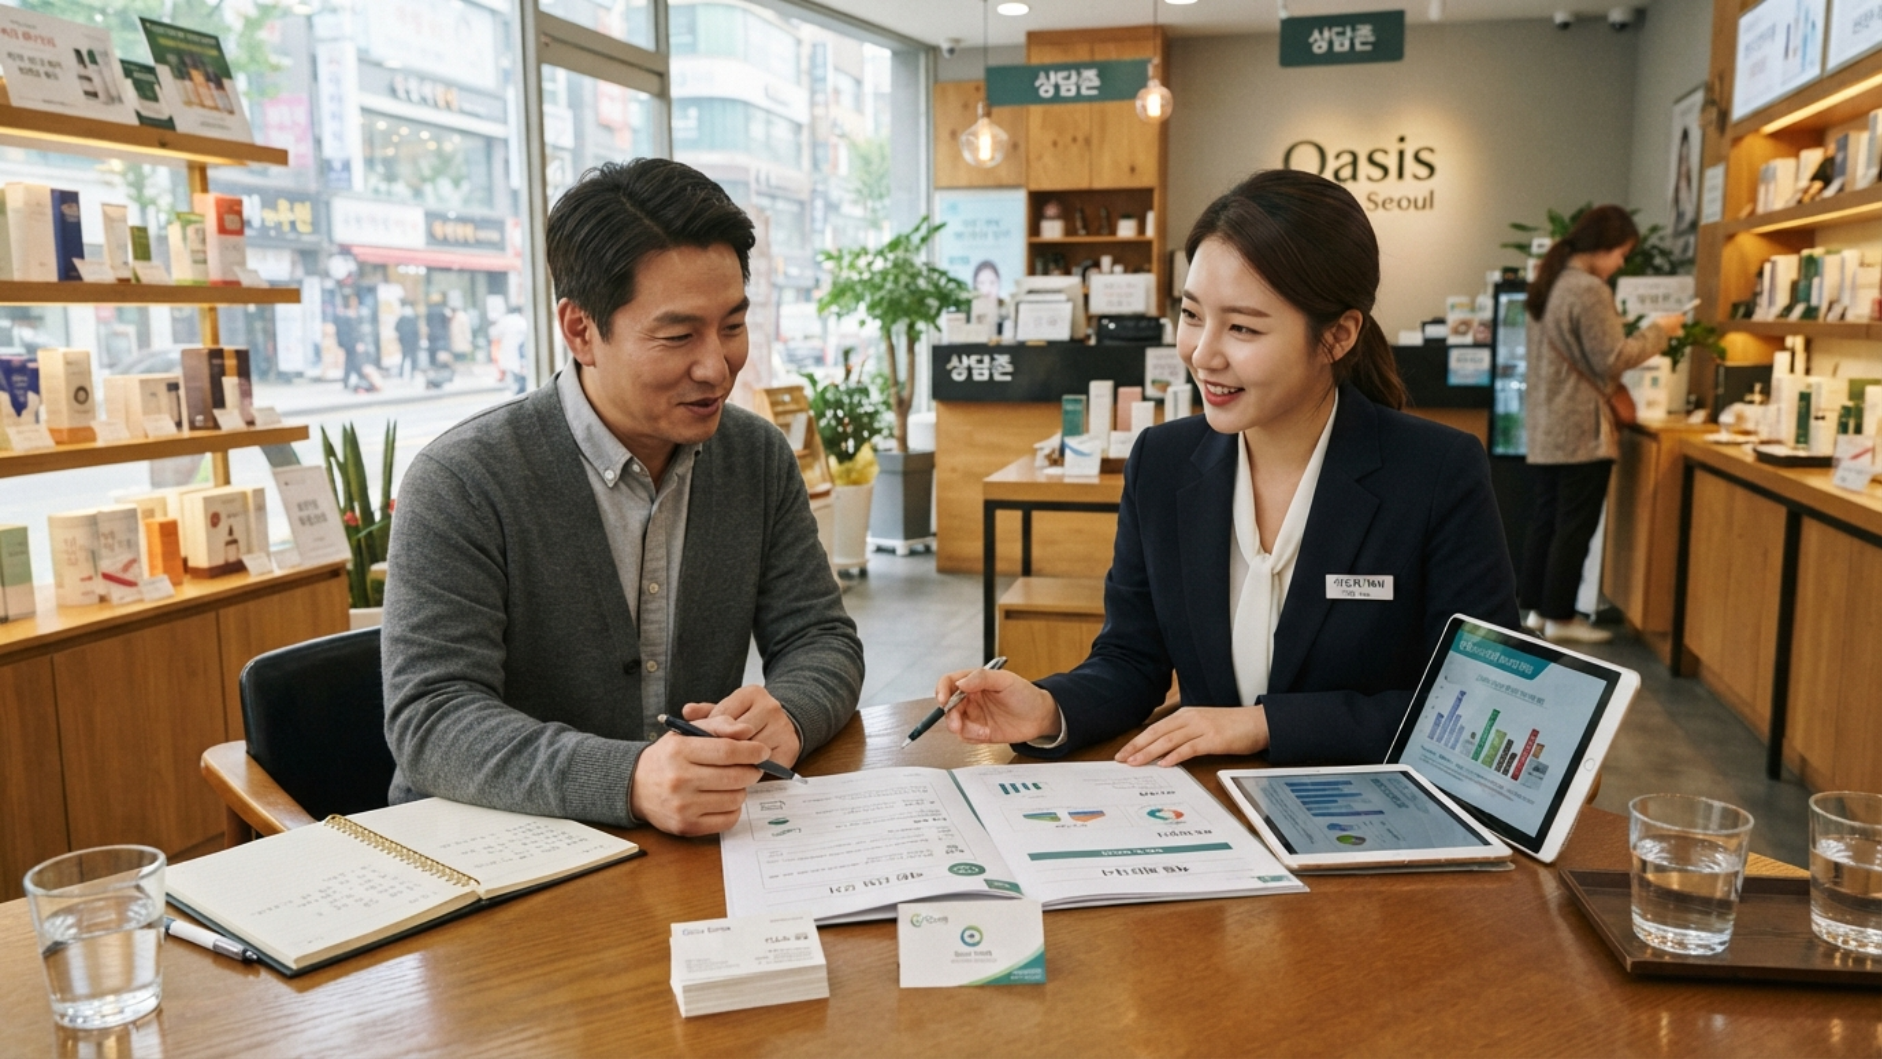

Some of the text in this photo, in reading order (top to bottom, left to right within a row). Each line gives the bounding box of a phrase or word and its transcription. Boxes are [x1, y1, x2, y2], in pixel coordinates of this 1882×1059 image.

[1308, 24, 1376, 54] 상담존
[1034, 68, 1101, 98] 상담존
[1283, 135, 1436, 183] Oasis
[1366, 190, 1434, 212] Seoul
[946, 353, 1013, 382] 상담존
